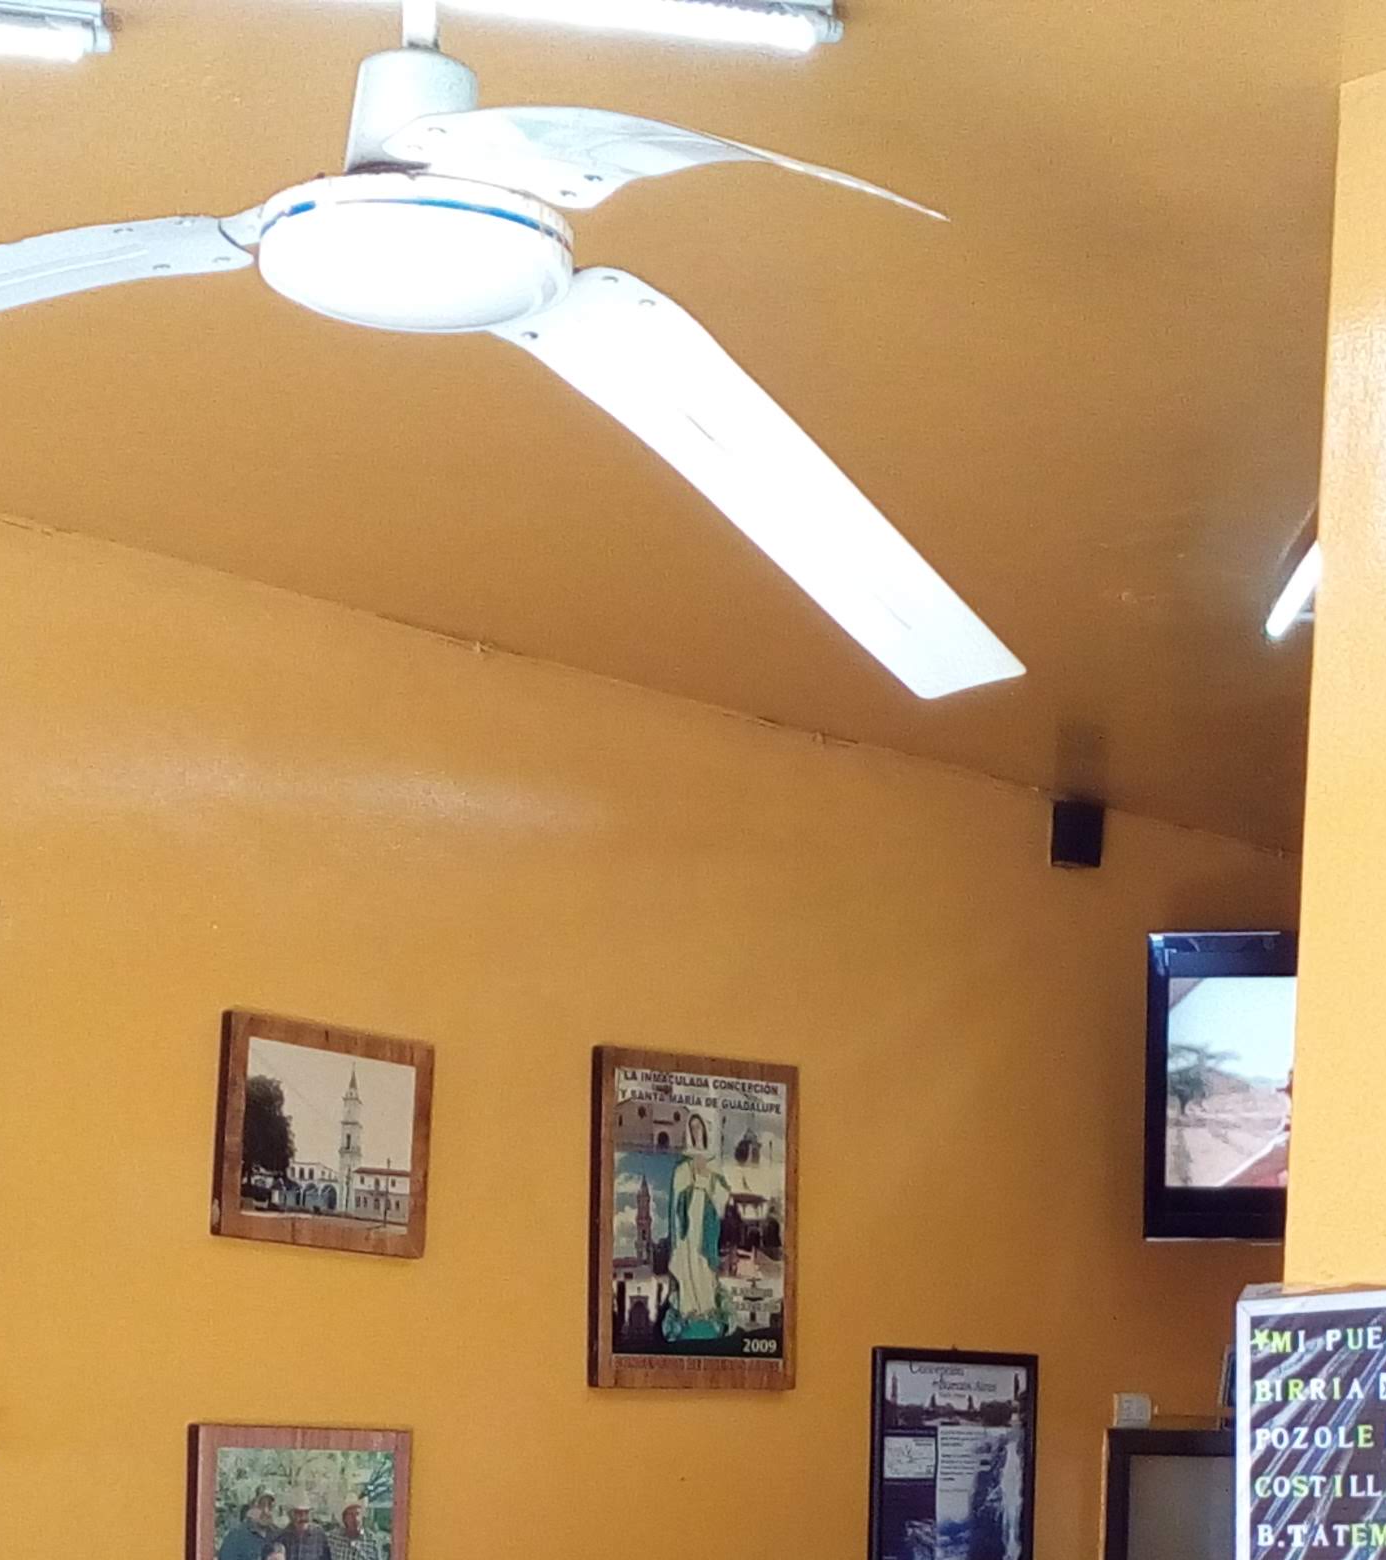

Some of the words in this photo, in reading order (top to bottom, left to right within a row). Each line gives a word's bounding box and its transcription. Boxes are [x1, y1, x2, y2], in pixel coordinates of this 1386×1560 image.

[742, 1338, 778, 1353] 2009
[1269, 1332, 1306, 1354] MI
[1254, 1380, 1364, 1402] BIRRIA
[1254, 1425, 1375, 1451] POZOLE
